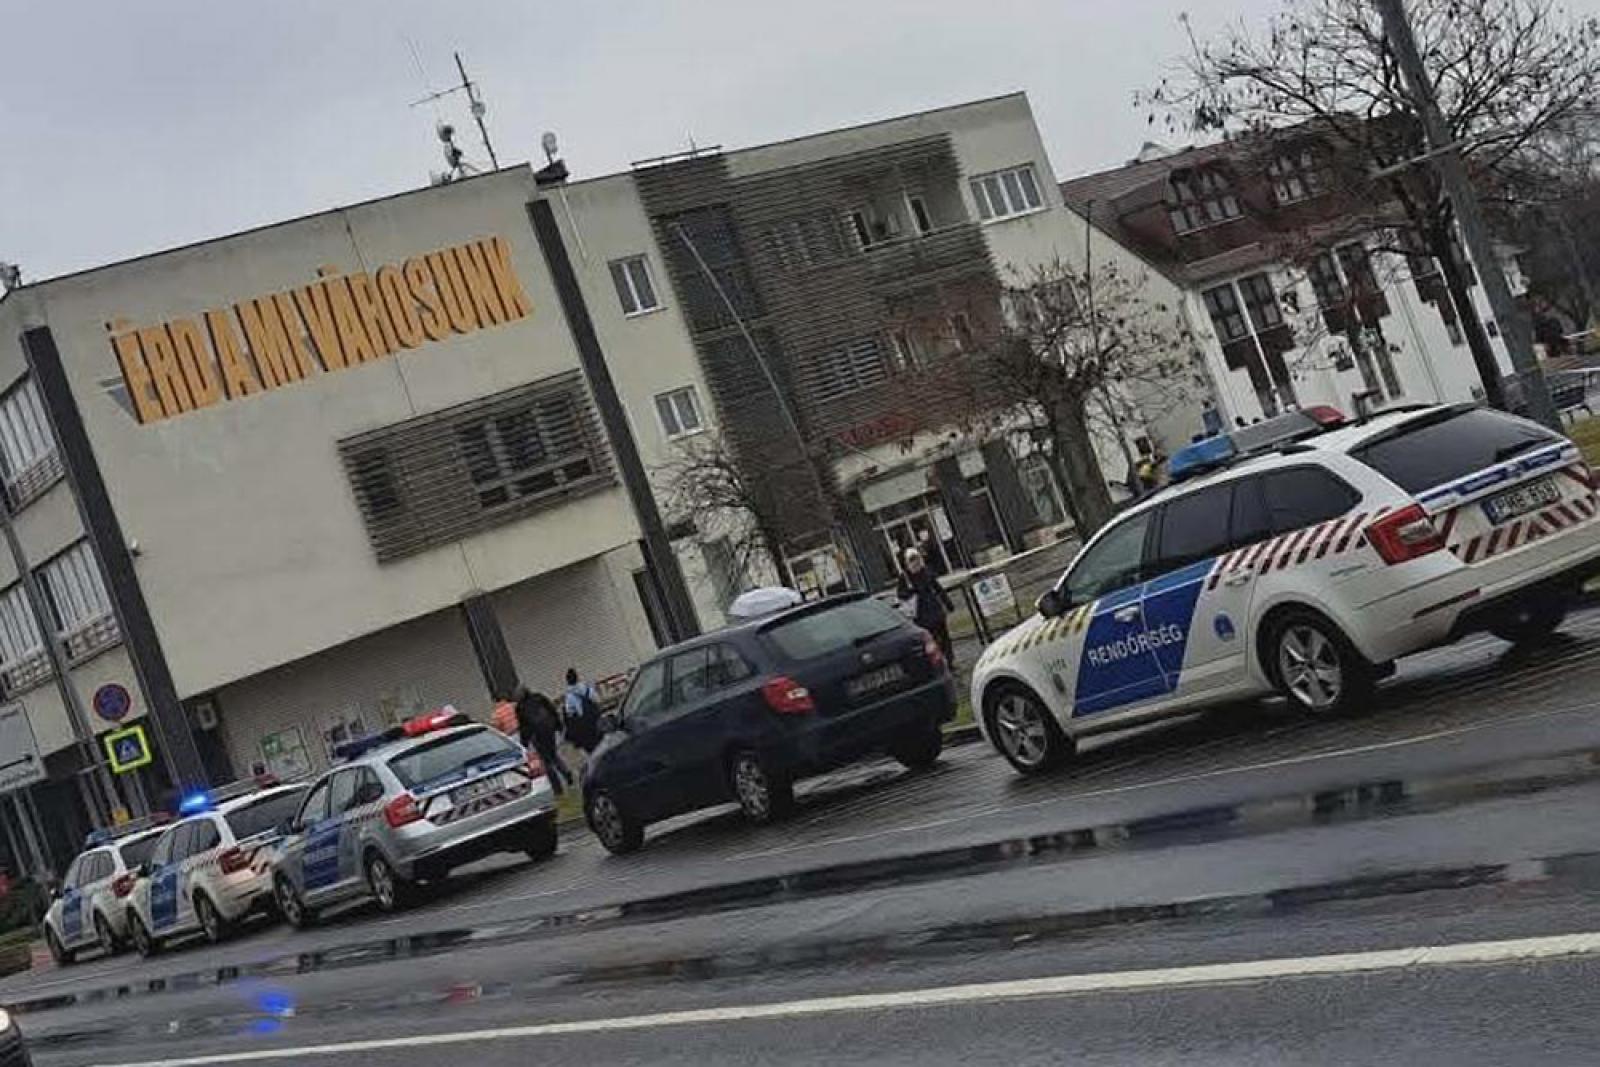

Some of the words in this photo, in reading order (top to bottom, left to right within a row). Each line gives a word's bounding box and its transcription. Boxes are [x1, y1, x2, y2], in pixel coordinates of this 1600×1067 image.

[107, 313, 218, 425] ÉRD
[204, 309, 259, 400] A
[234, 291, 316, 390] MI
[291, 234, 533, 372] VÁROSUNK
[1087, 622, 1184, 668] RENDŐRSÉG
